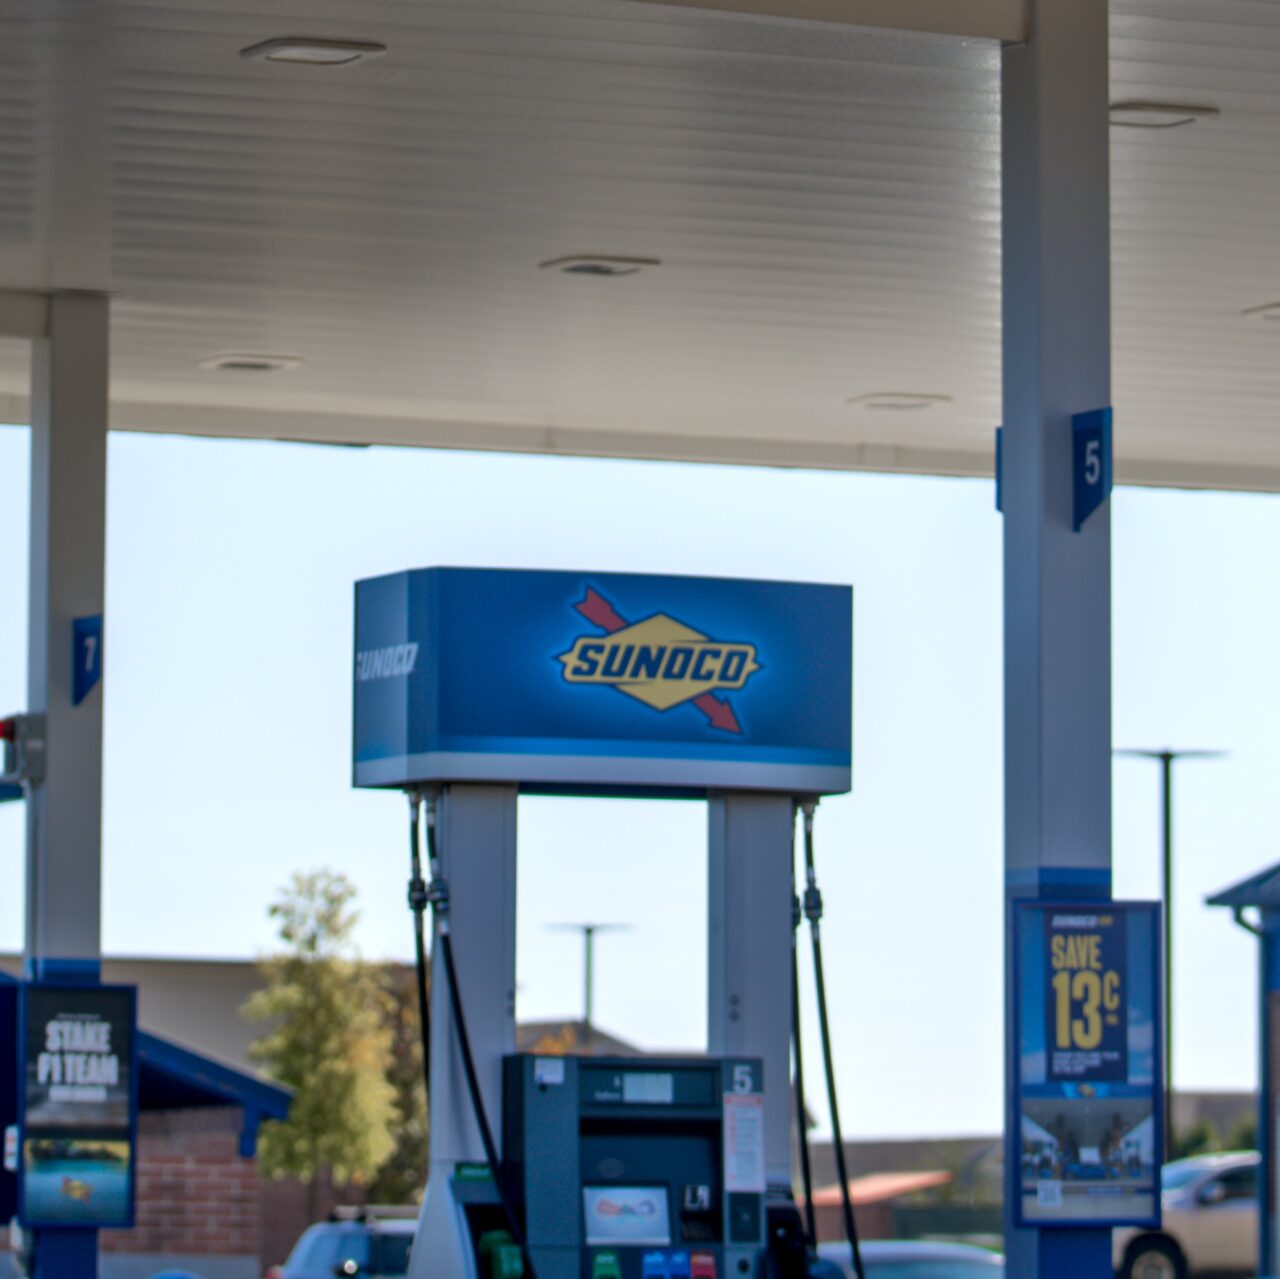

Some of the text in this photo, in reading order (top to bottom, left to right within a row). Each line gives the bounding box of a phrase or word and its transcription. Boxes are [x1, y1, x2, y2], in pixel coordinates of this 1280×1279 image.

[1084, 439, 1100, 486] 5
[570, 643, 750, 683] SUNOCO
[1051, 934, 1103, 970] SAVE
[46, 1021, 111, 1052] STAKE
[64, 1052, 119, 1086] TEAM
[734, 1064, 752, 1093] 5
